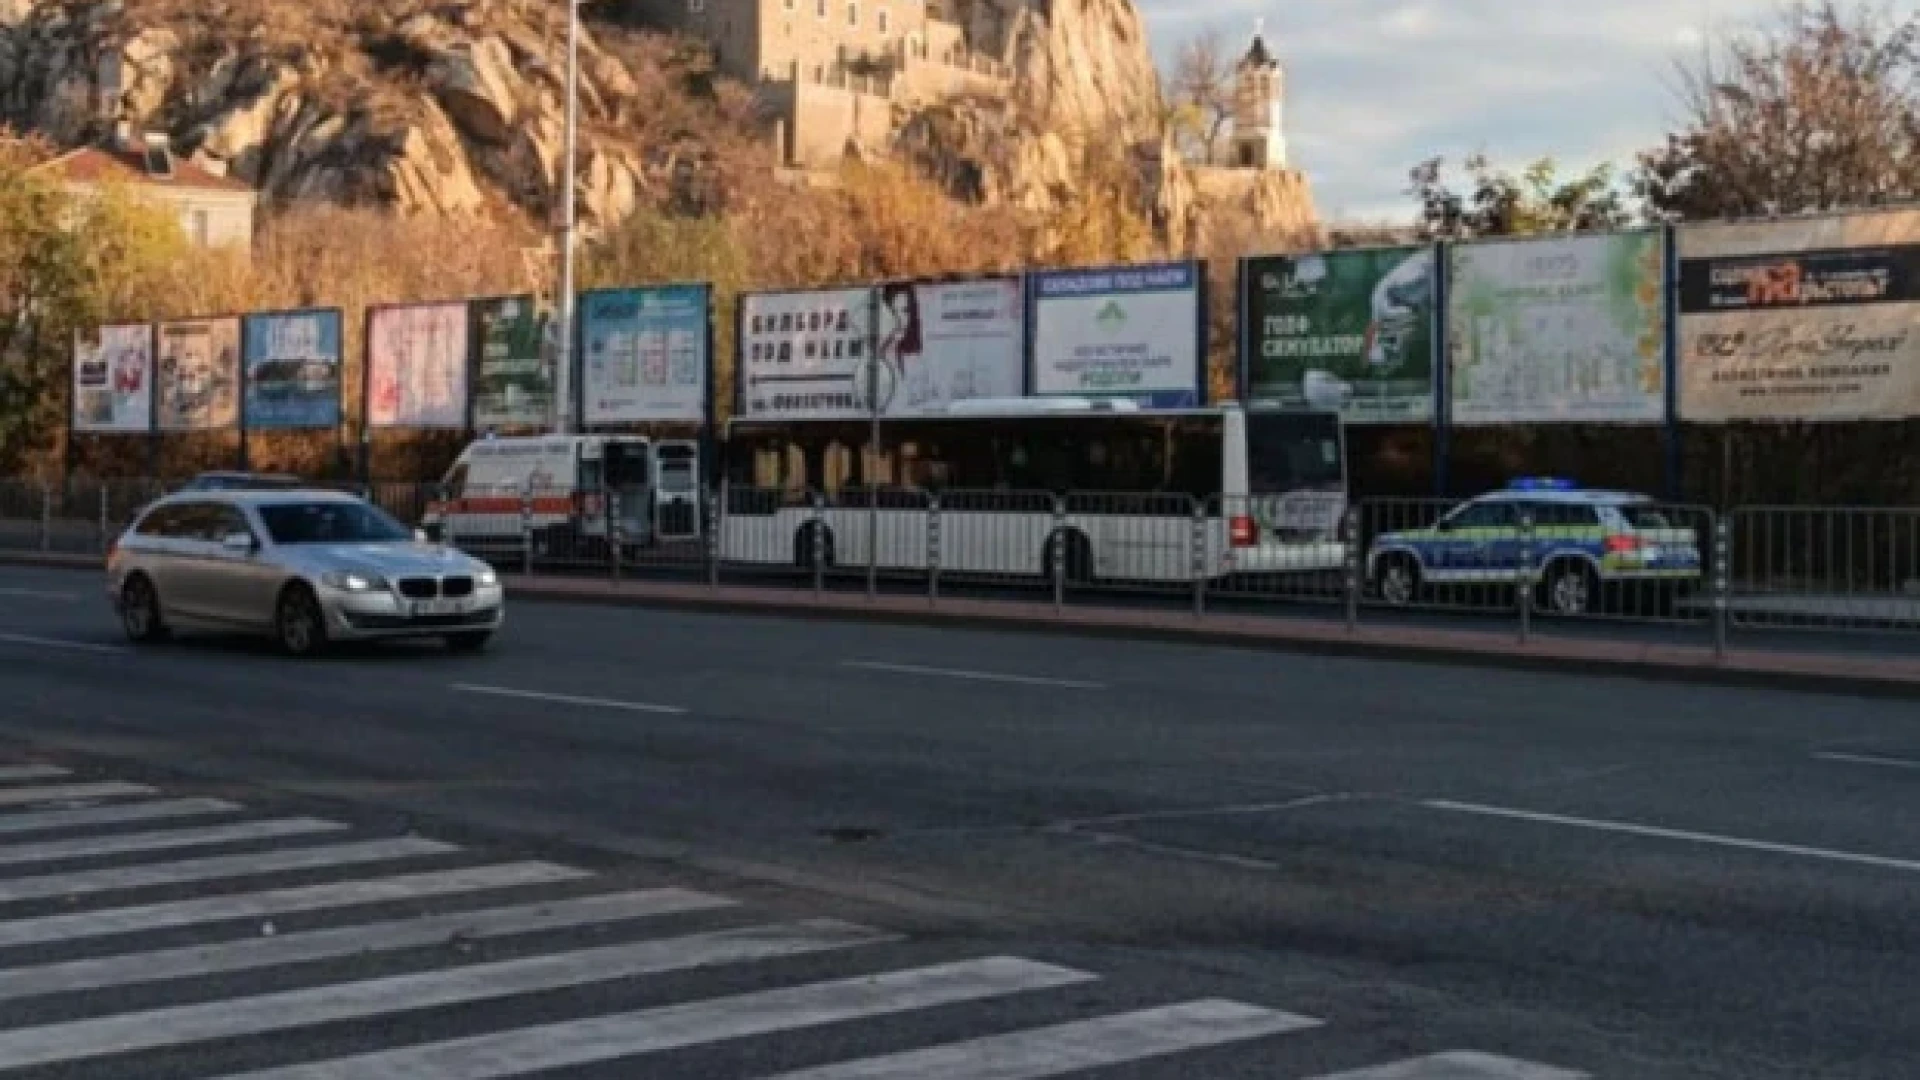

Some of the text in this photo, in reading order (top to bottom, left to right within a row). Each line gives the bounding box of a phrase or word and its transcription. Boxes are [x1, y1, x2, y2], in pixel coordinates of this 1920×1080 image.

[751, 310, 849, 334] БИЛБОРД
[751, 340, 863, 362] ПОД НАЕМ
[1262, 335, 1364, 357] СИМУЛАТОР
